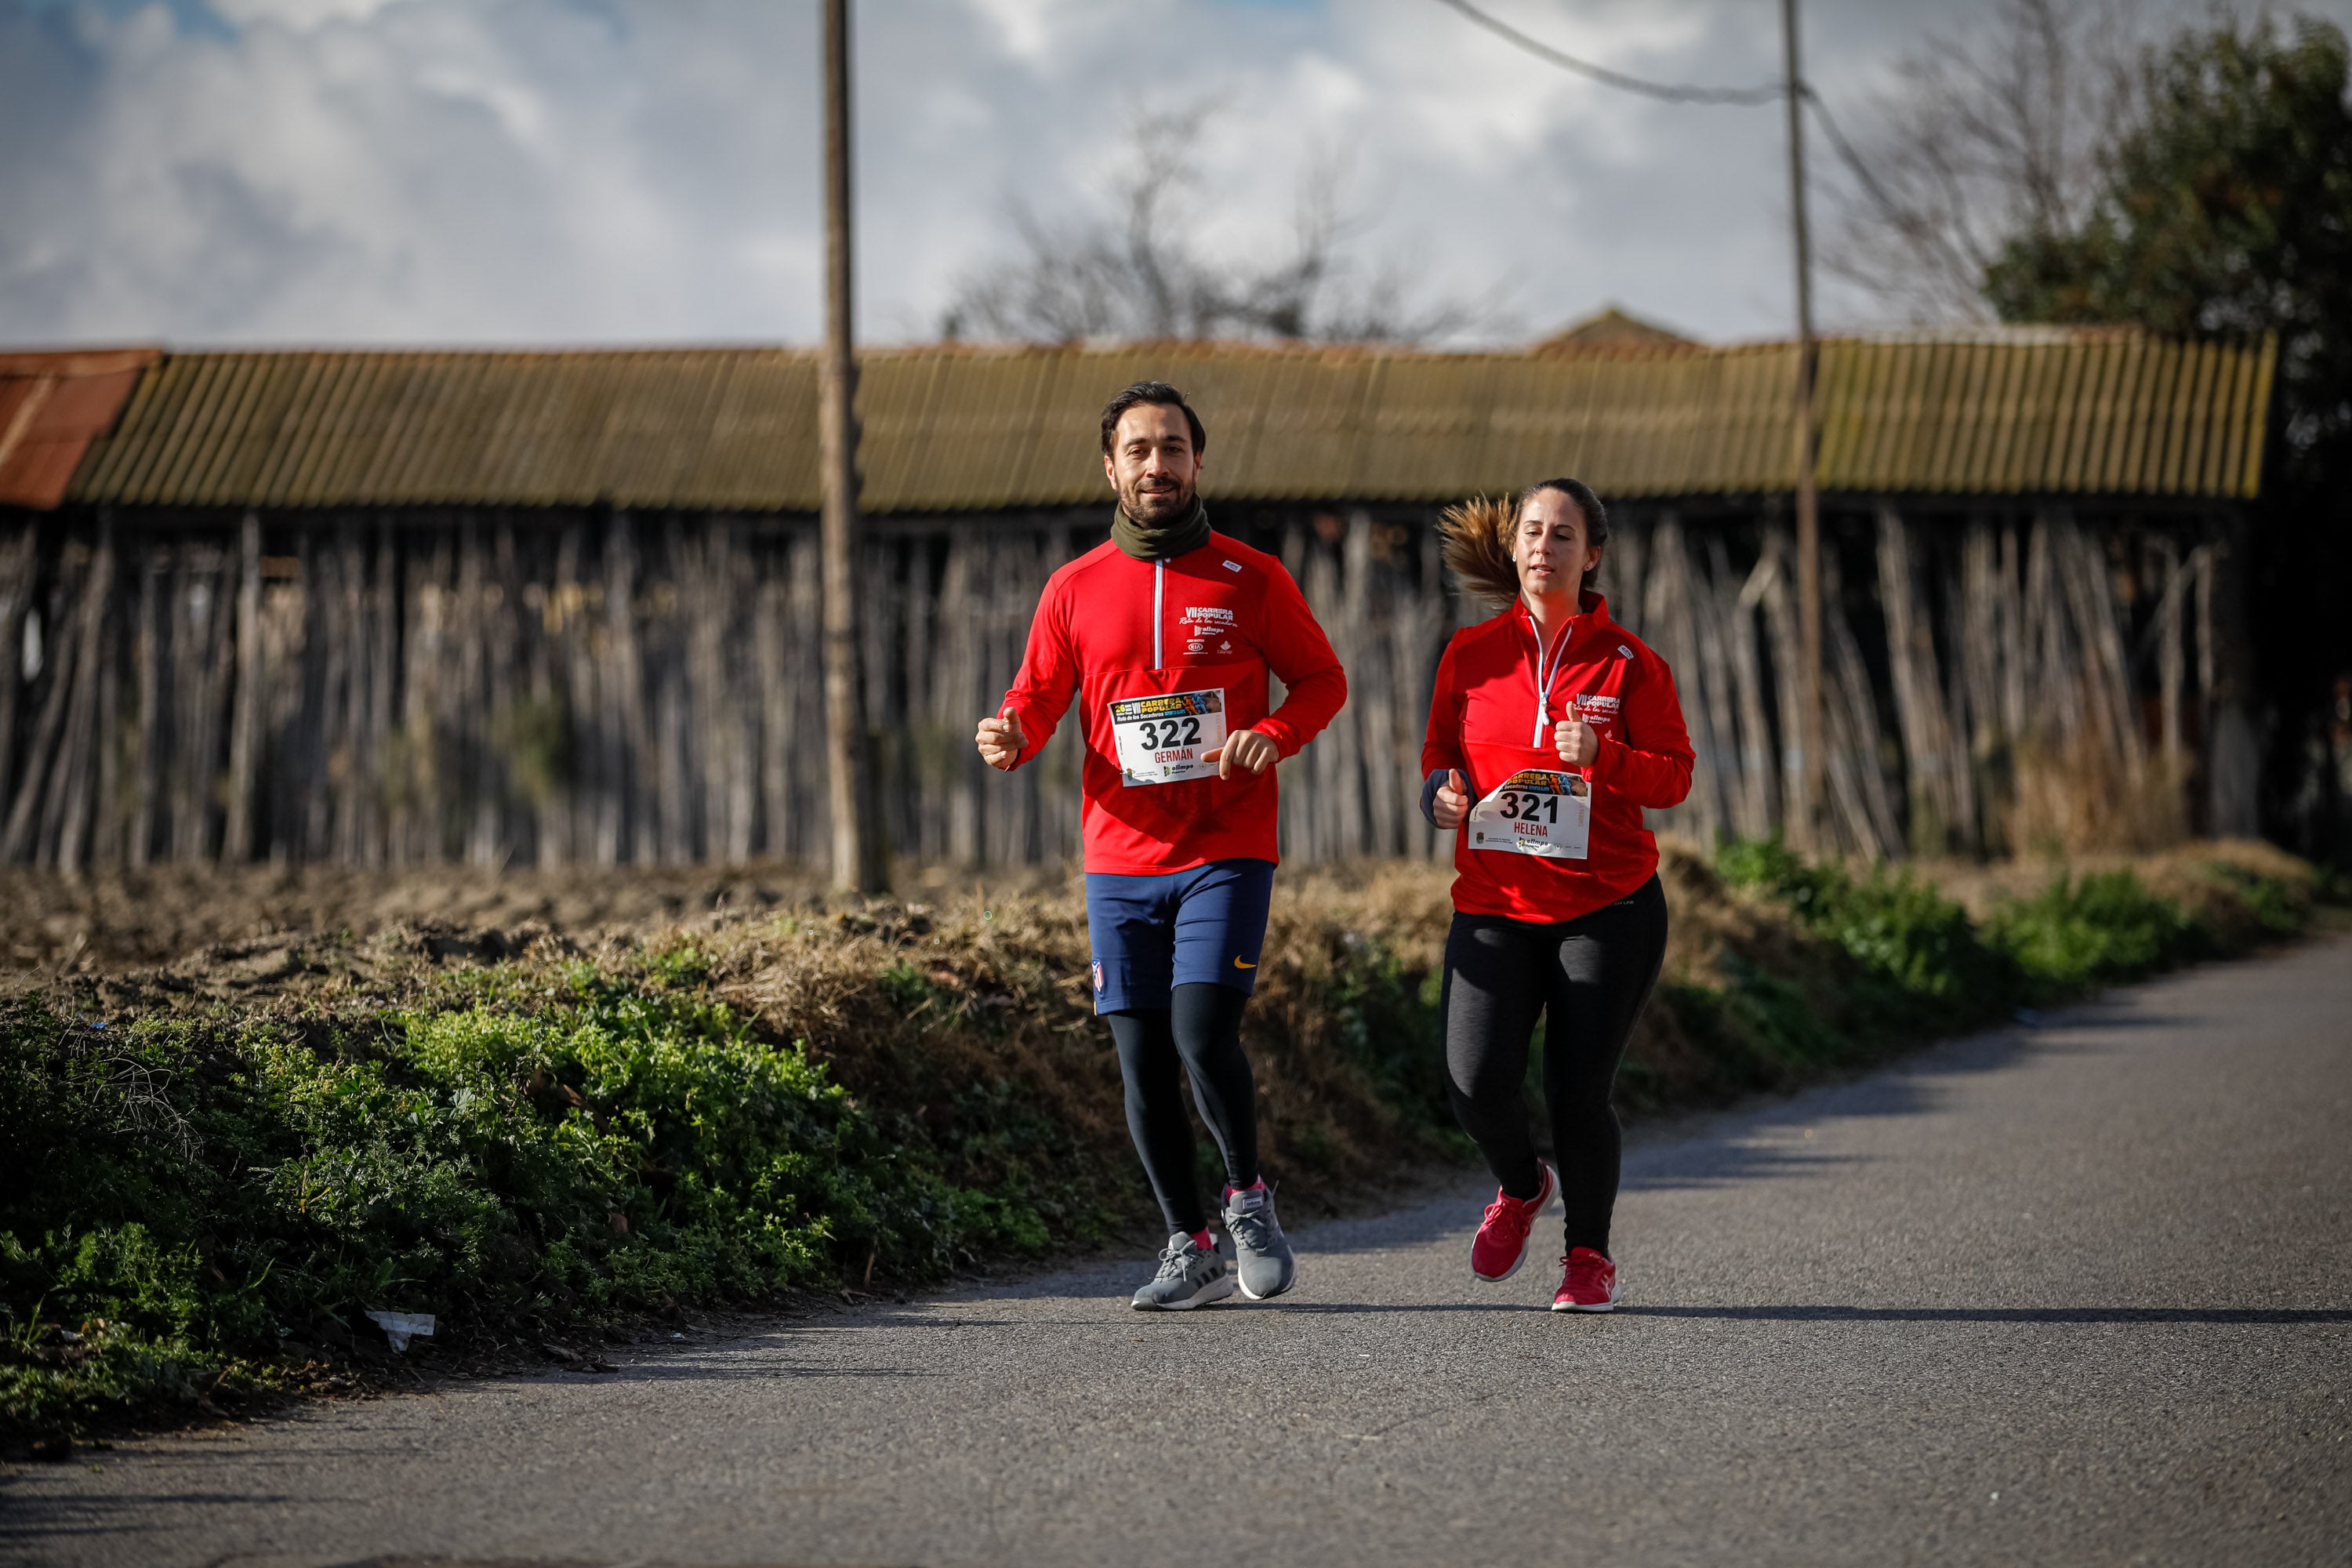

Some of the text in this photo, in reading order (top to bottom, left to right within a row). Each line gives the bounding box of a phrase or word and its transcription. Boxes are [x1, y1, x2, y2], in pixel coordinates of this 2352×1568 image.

[1185, 607, 1197, 618] VII
[1132, 702, 1141, 714] VII
[1141, 697, 1182, 708] CARRERA
[1577, 693, 1587, 706] VII
[1115, 704, 1125, 713] 26
[1141, 703, 1182, 713] POPULAR
[1139, 717, 1201, 750] 322
[1155, 746, 1193, 764] GERMÁN
[1500, 792, 1559, 824] 321
[1514, 822, 1548, 837] HELENA
